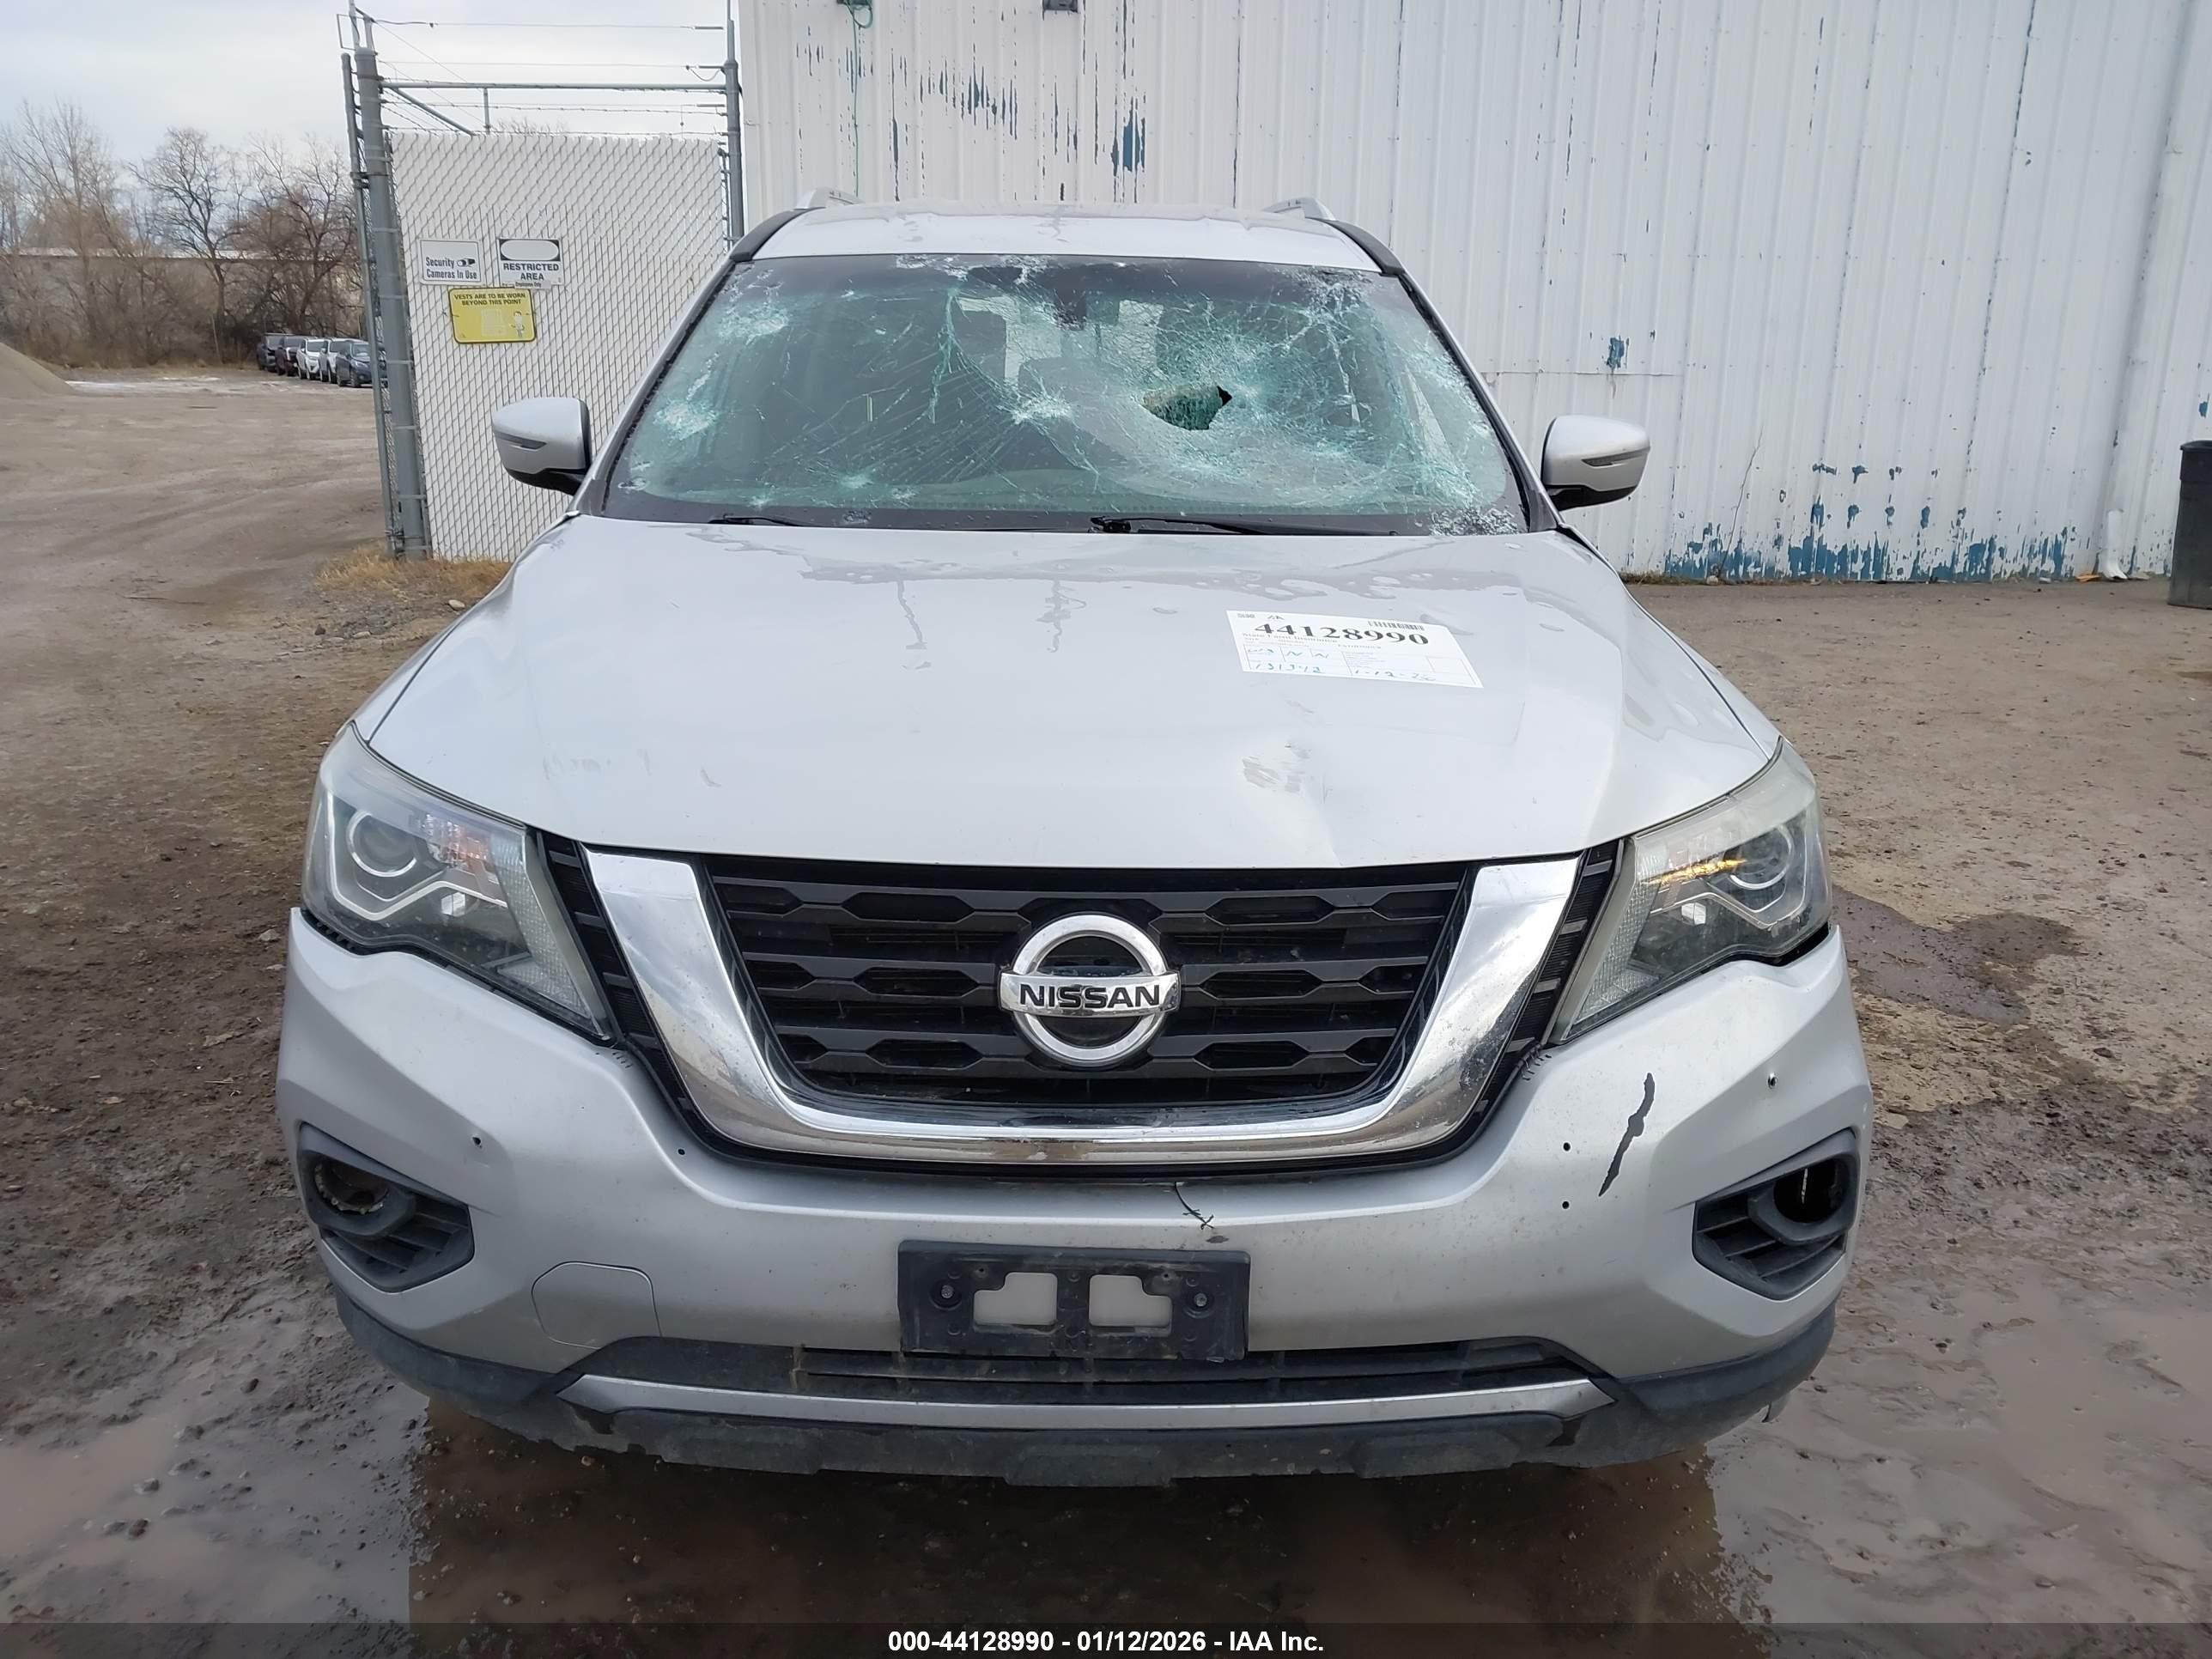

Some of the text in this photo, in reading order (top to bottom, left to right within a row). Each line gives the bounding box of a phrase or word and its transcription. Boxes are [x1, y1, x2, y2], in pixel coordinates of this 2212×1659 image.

[426, 257, 454, 269] Security
[503, 263, 559, 271] RESTRICTED
[427, 269, 477, 279] Cameras In Use
[520, 272, 544, 281] AREA
[1255, 623, 1429, 645] 44128990
[1019, 984, 1160, 1008] NISSAN
